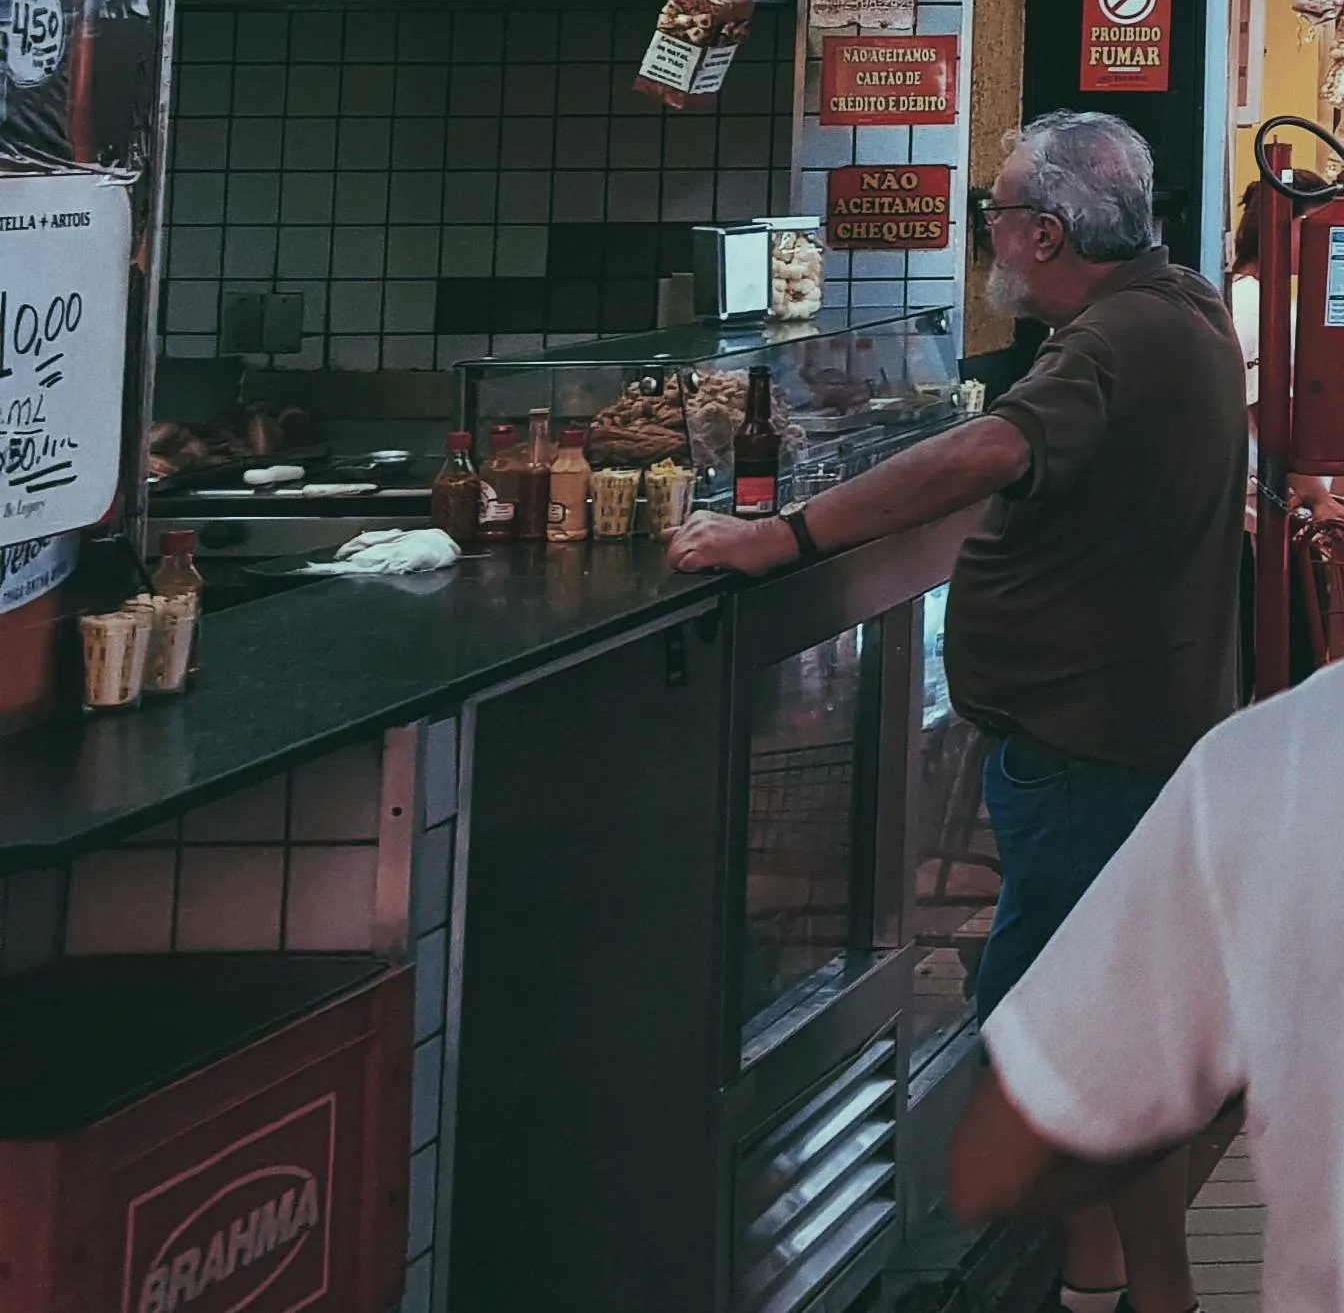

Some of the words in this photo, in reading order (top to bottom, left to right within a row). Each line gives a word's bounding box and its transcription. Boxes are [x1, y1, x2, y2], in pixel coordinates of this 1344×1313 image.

[1090, 26, 1162, 42] PROIBIDO
[870, 48, 937, 63] ACEITAMOS
[1088, 46, 1161, 66] FUMAR
[856, 68, 904, 86] CARTÃO
[905, 71, 922, 86] DE
[829, 93, 886, 112] CRÉDITO
[889, 96, 897, 112] E
[899, 92, 947, 112] DÉBITO
[861, 168, 919, 190] NÃO
[834, 196, 947, 214] ACEITAMOS
[50, 211, 91, 229] ARTOIS
[836, 221, 942, 242] CHEQUES
[138, 1177, 319, 1313] BRAHMA
